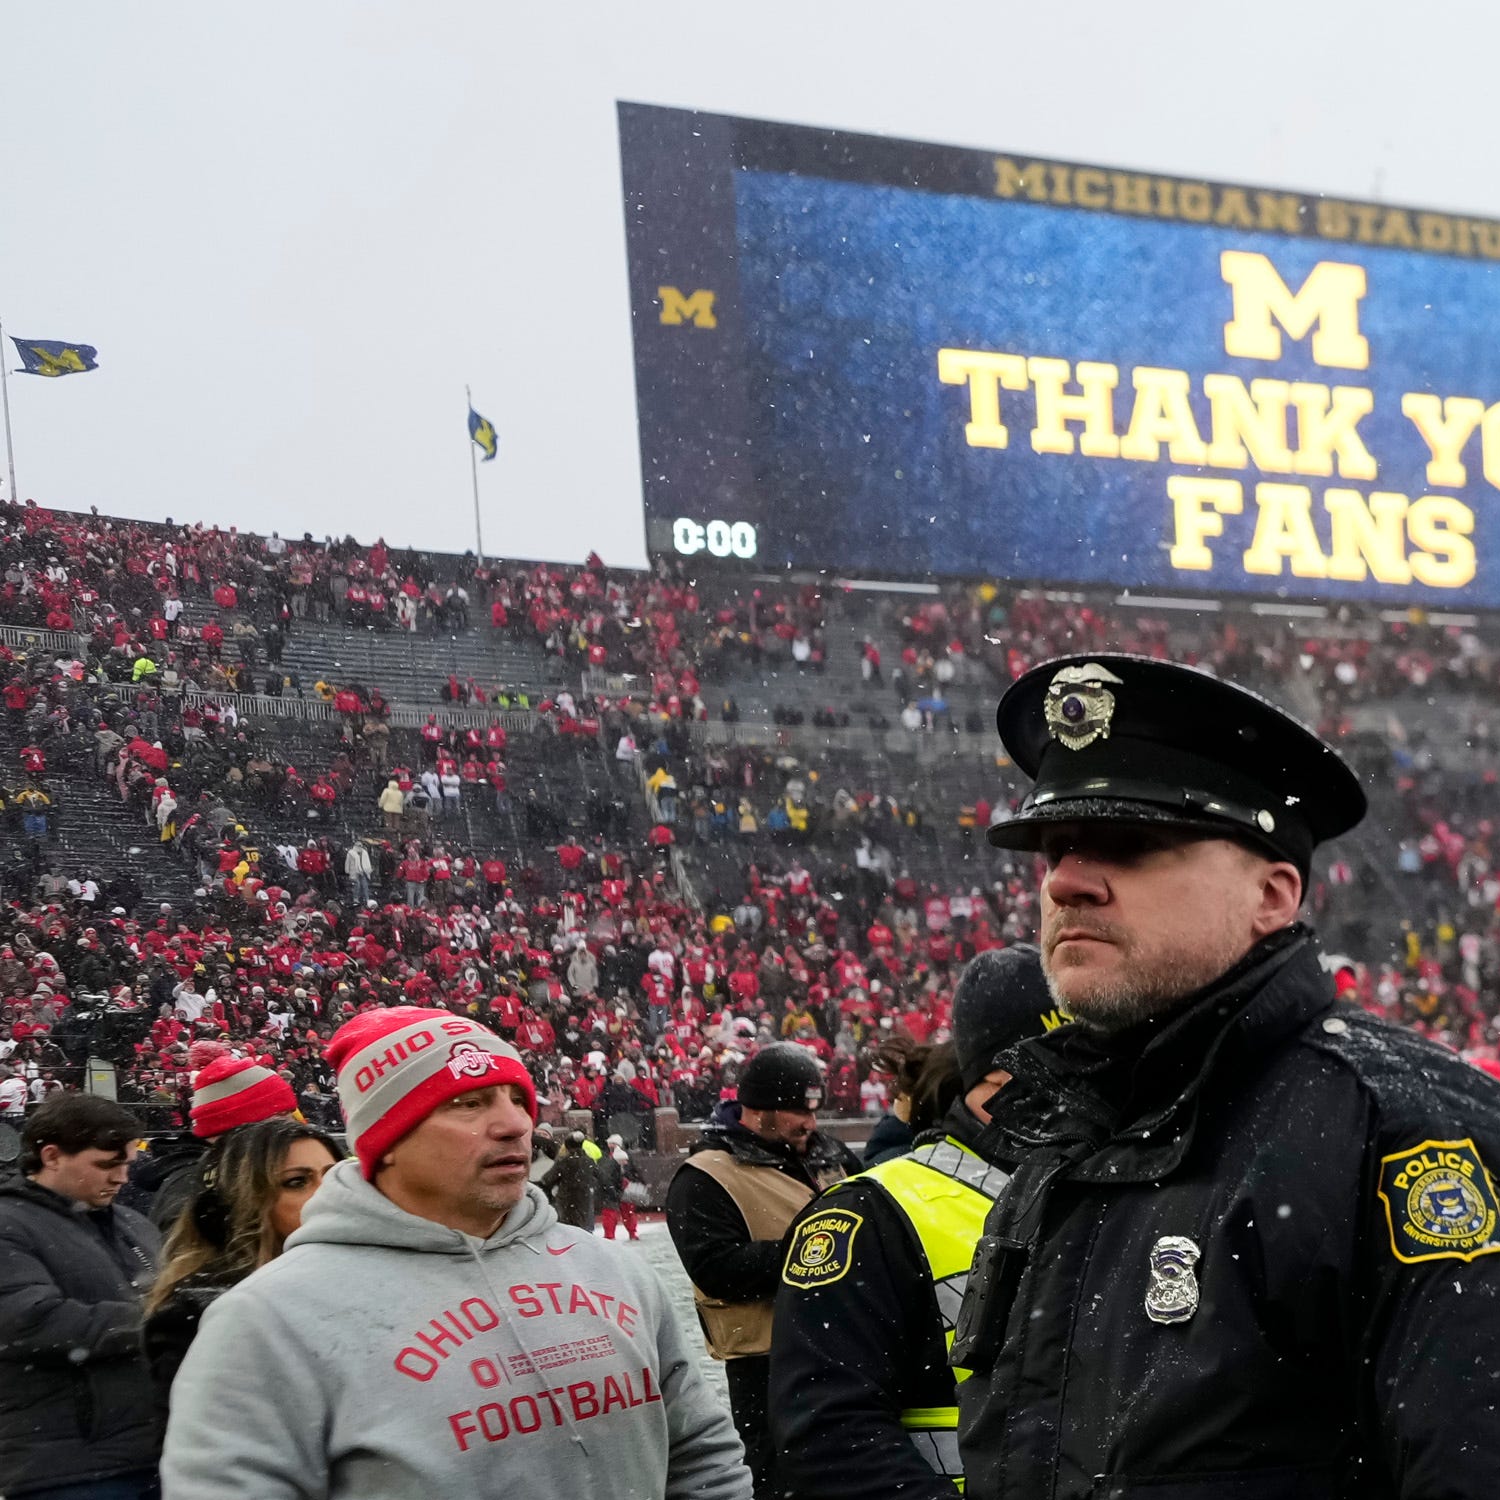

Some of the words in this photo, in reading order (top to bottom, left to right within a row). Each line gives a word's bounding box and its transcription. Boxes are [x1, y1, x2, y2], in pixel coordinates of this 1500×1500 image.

[993, 157, 1301, 234] MICHIGAN
[658, 285, 717, 328] M
[1220, 249, 1370, 371] M
[937, 347, 1378, 481] THANK
[673, 517, 758, 559] 0:00
[1166, 475, 1477, 589] FANS
[354, 1029, 436, 1093] OHIO
[1394, 1152, 1475, 1190] POLICE
[802, 1218, 852, 1237] MICHIGAN
[1403, 1221, 1459, 1249] UNIVERSITY
[1460, 1237, 1474, 1249] OF
[789, 1262, 809, 1277] STATE
[807, 1259, 841, 1277] POLICE
[394, 1297, 500, 1382] OHIO
[508, 1282, 639, 1338] STATE
[447, 1367, 662, 1452] FOOTBALL
